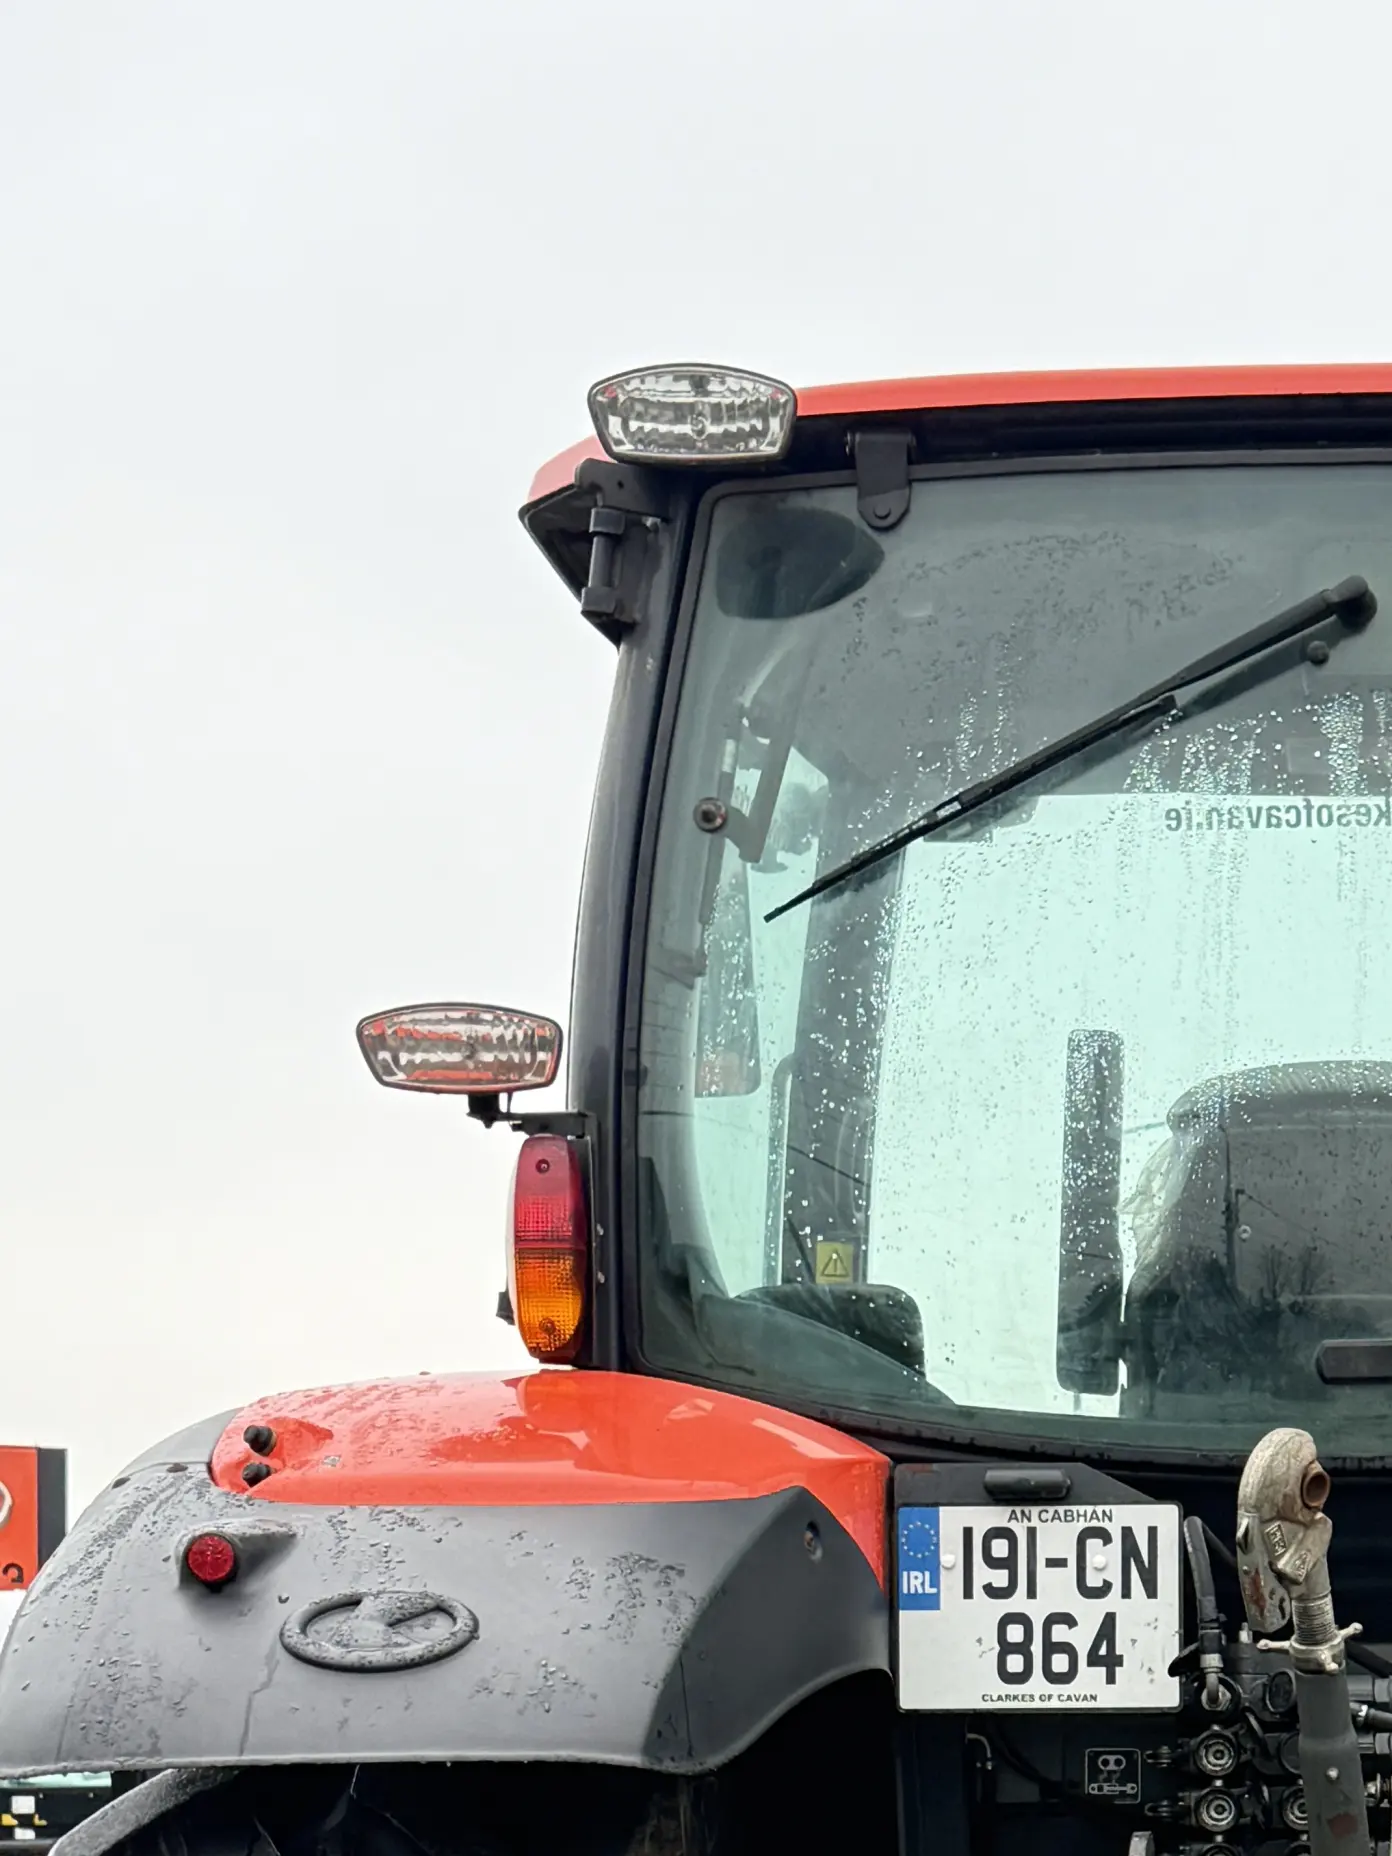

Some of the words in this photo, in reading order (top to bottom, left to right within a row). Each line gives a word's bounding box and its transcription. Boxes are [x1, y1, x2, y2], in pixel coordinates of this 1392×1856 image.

[1007, 1508, 1032, 1524] AN
[962, 1525, 1159, 1600] 191-CN
[902, 1570, 938, 1595] IRL
[996, 1611, 1125, 1686] 864
[981, 1693, 1036, 1703] CLARKES
[1039, 1693, 1054, 1703] OF
[1057, 1693, 1099, 1703] CAVAN
